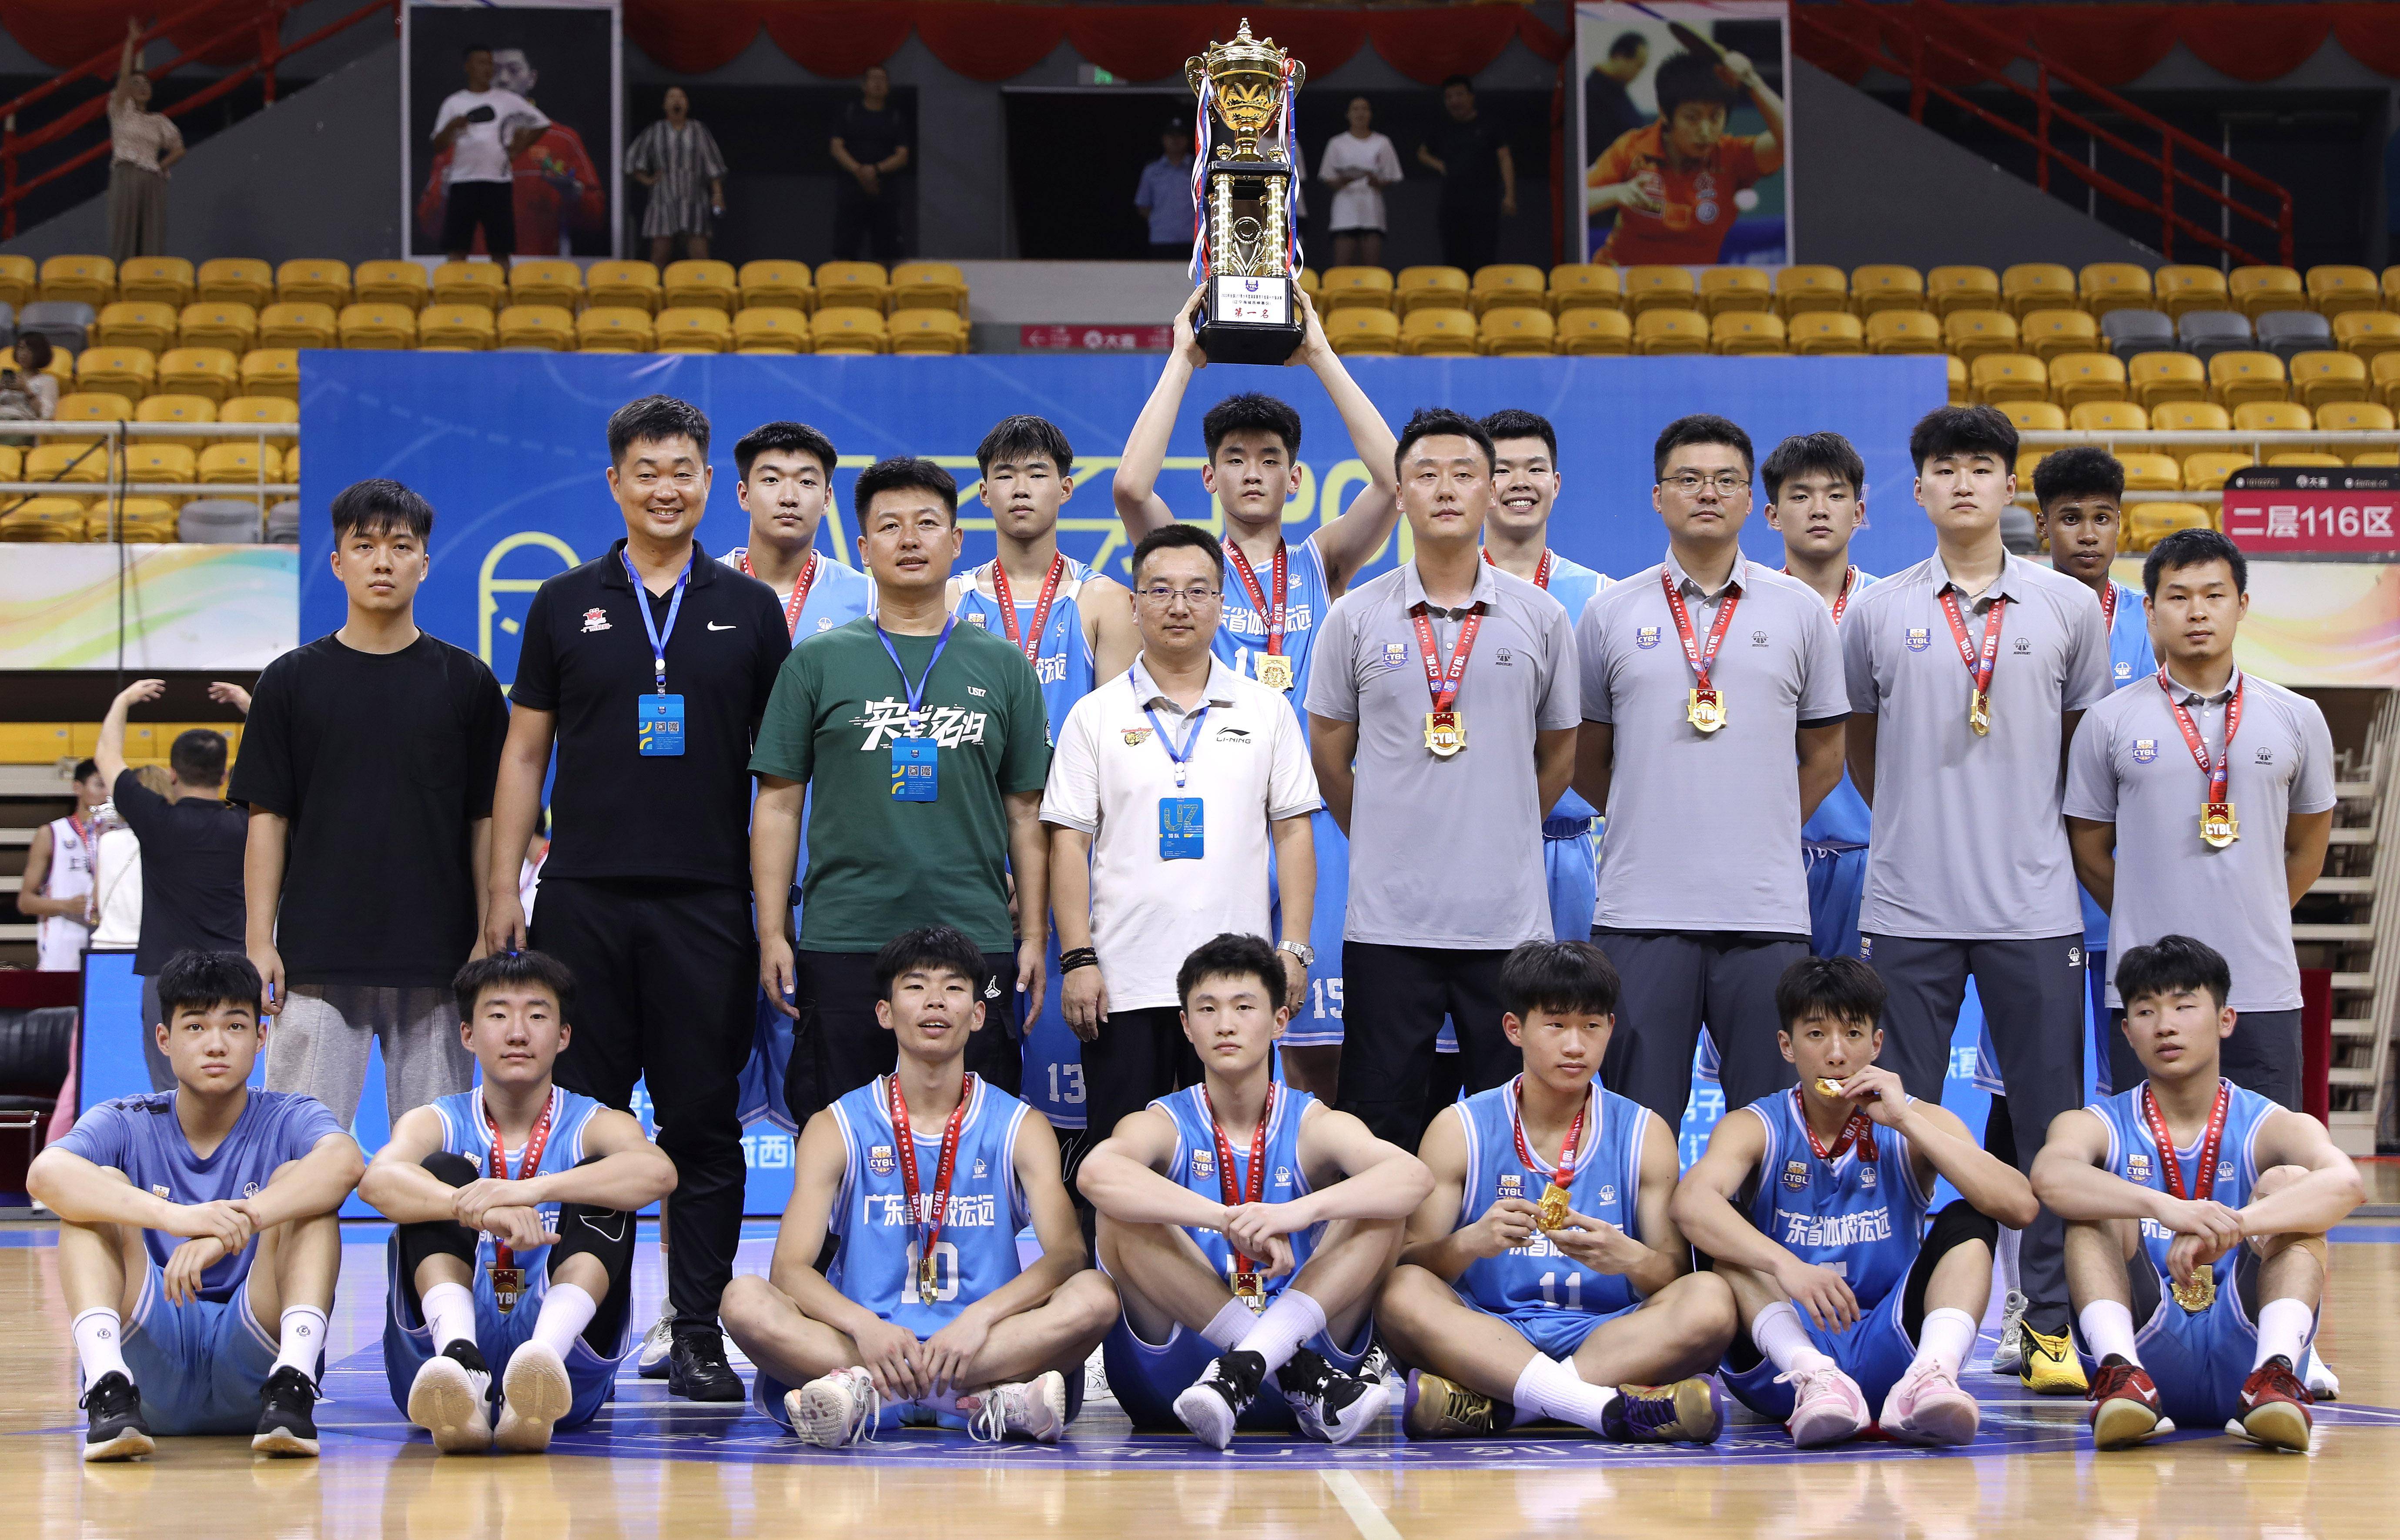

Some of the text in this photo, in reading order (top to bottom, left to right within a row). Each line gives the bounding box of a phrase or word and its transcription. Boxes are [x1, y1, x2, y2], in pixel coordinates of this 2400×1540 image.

[1235, 307, 1269, 318] 第一名
[2231, 505, 2394, 539] 二层116区
[1258, 604, 1273, 625] CYBL
[1274, 602, 1283, 621] CYBL
[1024, 637, 1039, 660] CYBL
[1683, 637, 1698, 660] CYBL
[1704, 632, 1721, 656] CYBL
[1958, 637, 1975, 661] CYBL
[1982, 633, 1998, 656] CYBL
[1424, 653, 1440, 677] CYBL
[1448, 652, 1466, 678] CYBL
[1693, 708, 1719, 721] CYBL
[1430, 733, 1459, 743] CYBL
[2192, 744, 2210, 769] CYBL
[2206, 824, 2233, 835] CYBL
[1313, 978, 1344, 1019] 15
[1048, 1063, 1087, 1104] 13
[1842, 1116, 1861, 1140] CYBL
[1192, 1161, 1215, 1172] CYBL
[2126, 1166, 2152, 1175] CYBL
[1784, 1173, 1808, 1184] CYBL
[931, 1188, 946, 1215] CYBL
[1498, 1186, 1523, 1196] CYBL
[910, 1192, 924, 1218] CYBL
[1772, 1205, 1892, 1247] 广东省体校宏远
[901, 1240, 958, 1303] 10
[1240, 1296, 1261, 1307] YBL
[1539, 1271, 1583, 1310] 11
